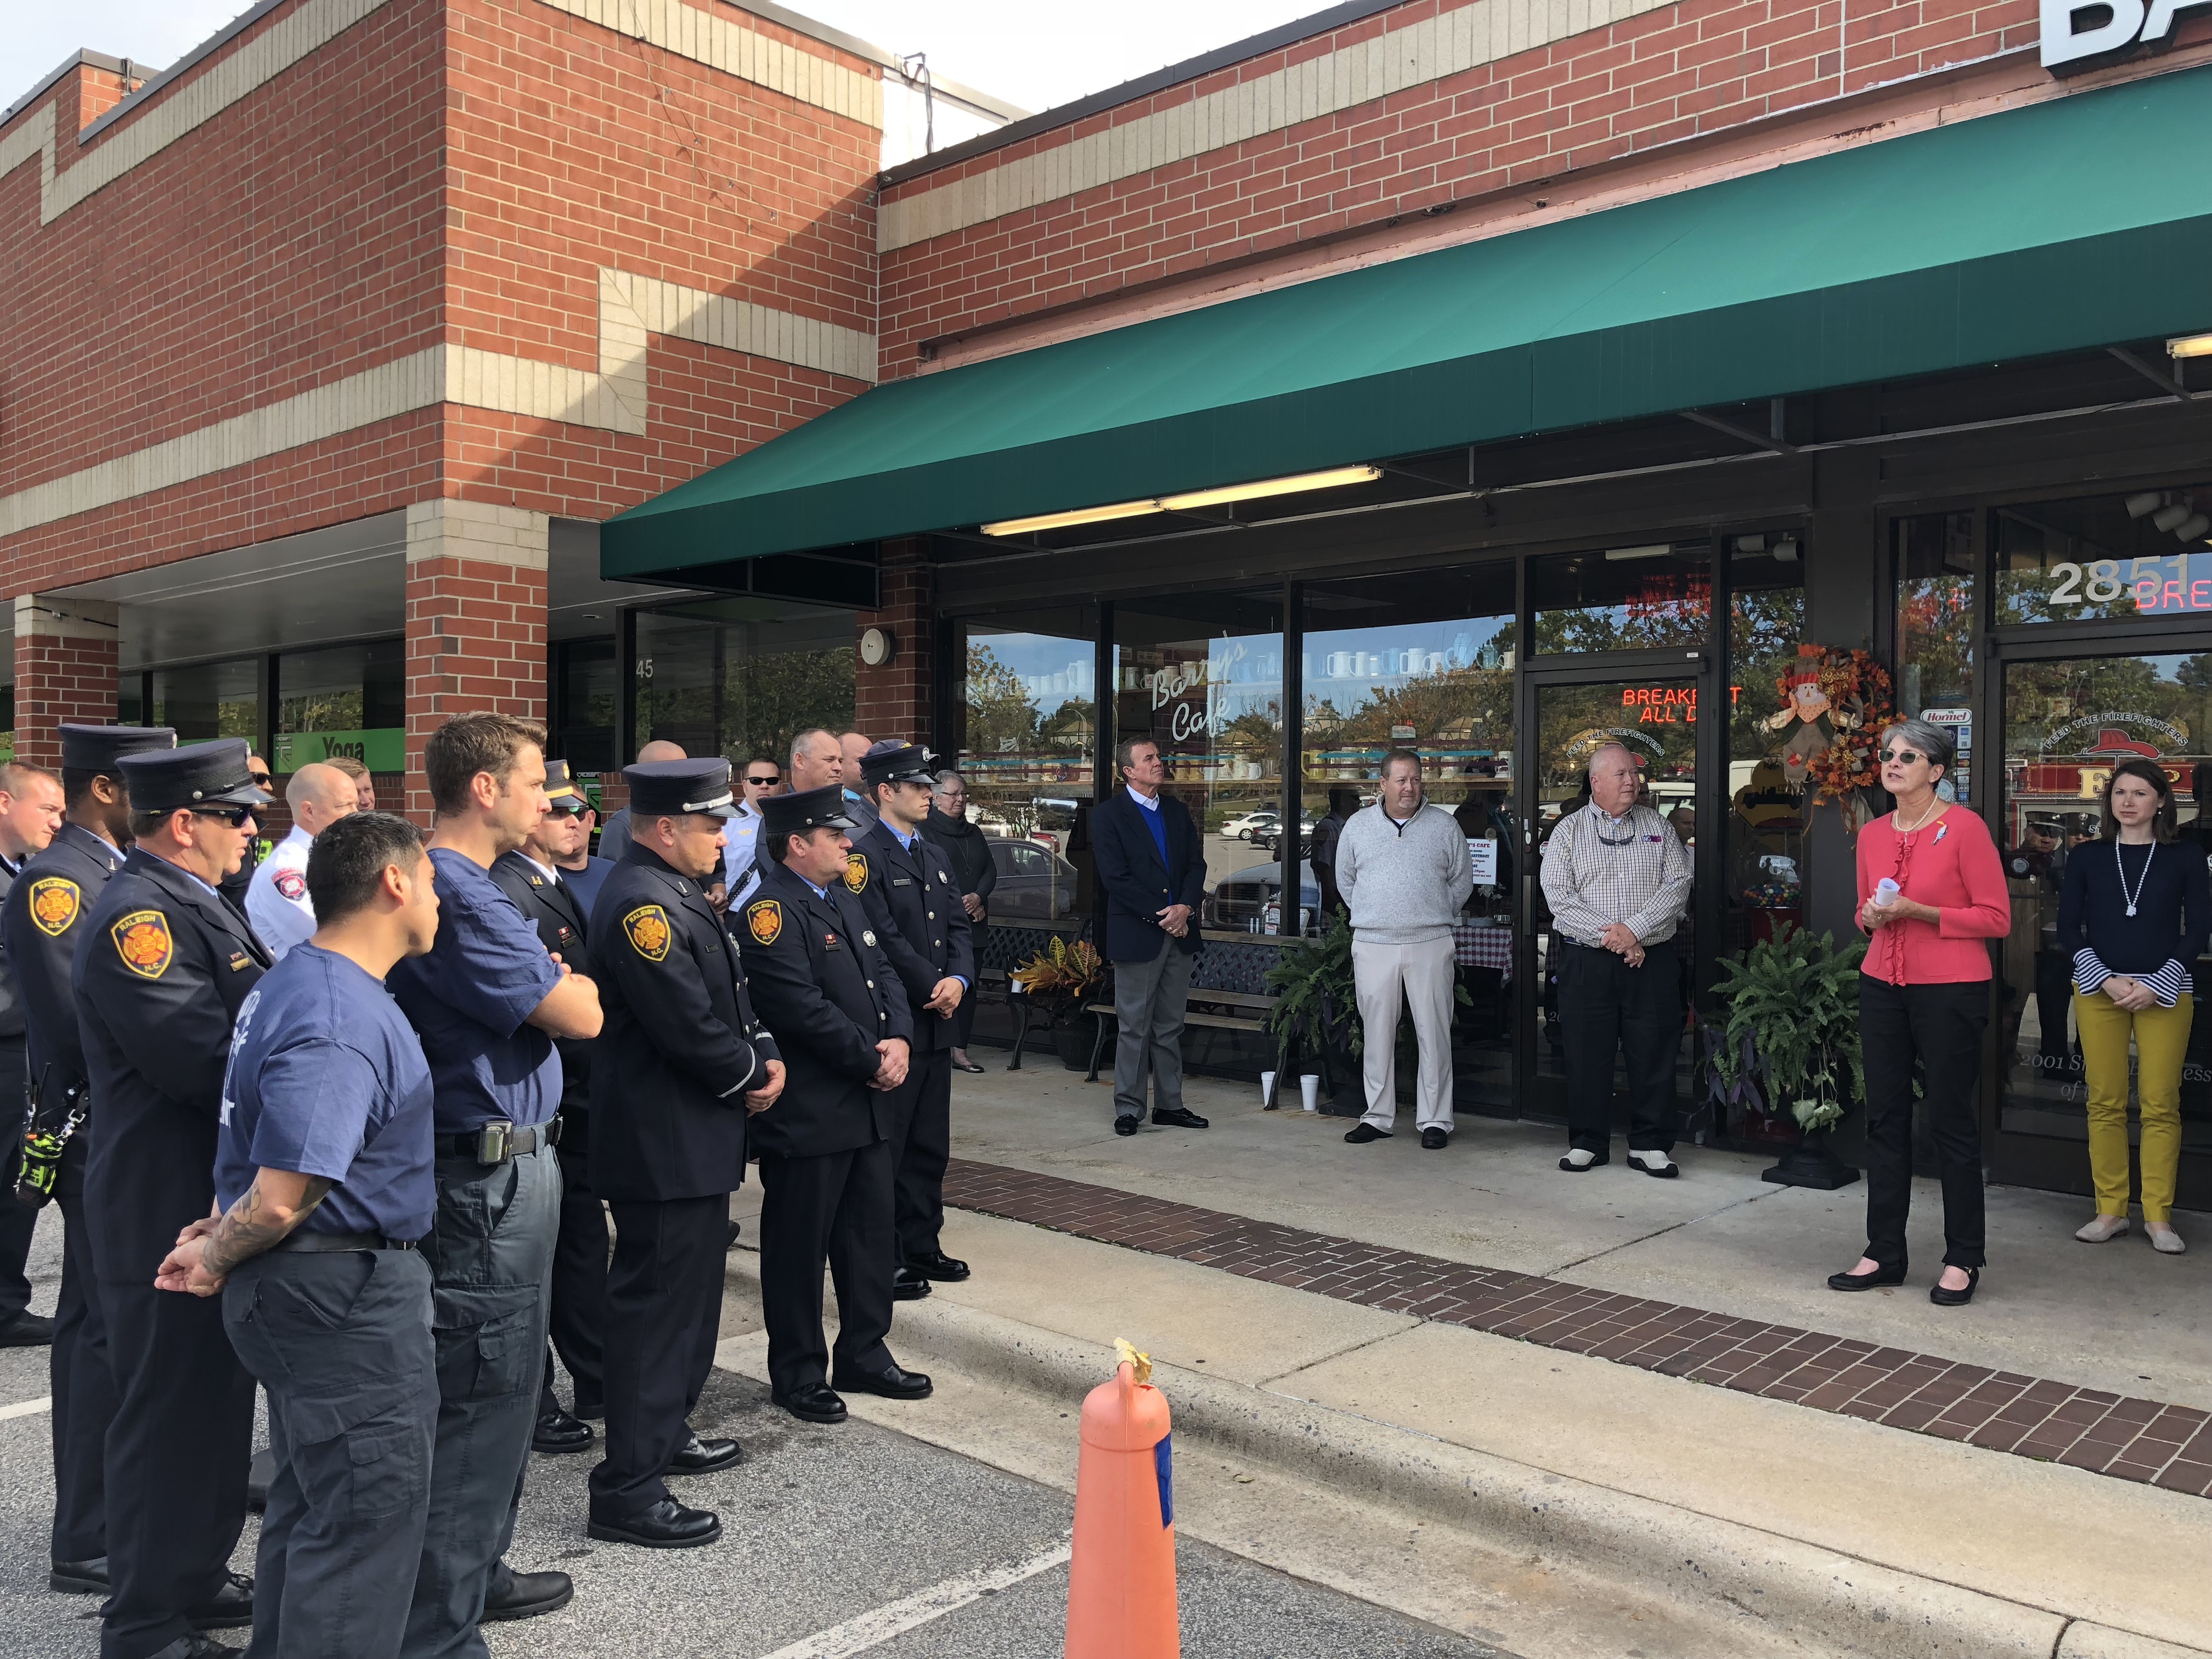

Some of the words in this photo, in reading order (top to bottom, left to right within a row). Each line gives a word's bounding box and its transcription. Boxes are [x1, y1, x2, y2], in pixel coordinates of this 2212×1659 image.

[2049, 553, 2188, 605] 2851
[636, 659, 653, 678] 45
[1639, 706, 1677, 723] ALL
[1927, 712, 1967, 721] Hormel
[2044, 725, 2072, 749] FEED
[2072, 714, 2098, 729] THE
[2101, 712, 2189, 747] FIREFIGHTERS
[1566, 739, 1585, 759] FEED
[1586, 729, 1604, 741] THE
[1606, 727, 1666, 757] FIREFIGHTERS
[37, 881, 71, 890] RALEIGH
[751, 902, 774, 913] RALEIGH
[119, 915, 156, 931] RALEIGH
[628, 909, 656, 923] RALEIGH
[651, 947, 664, 956] N.C.
[144, 962, 162, 973] N.C.
[2020, 1054, 2063, 1069] 2001
[2061, 1080, 2082, 1102] of
